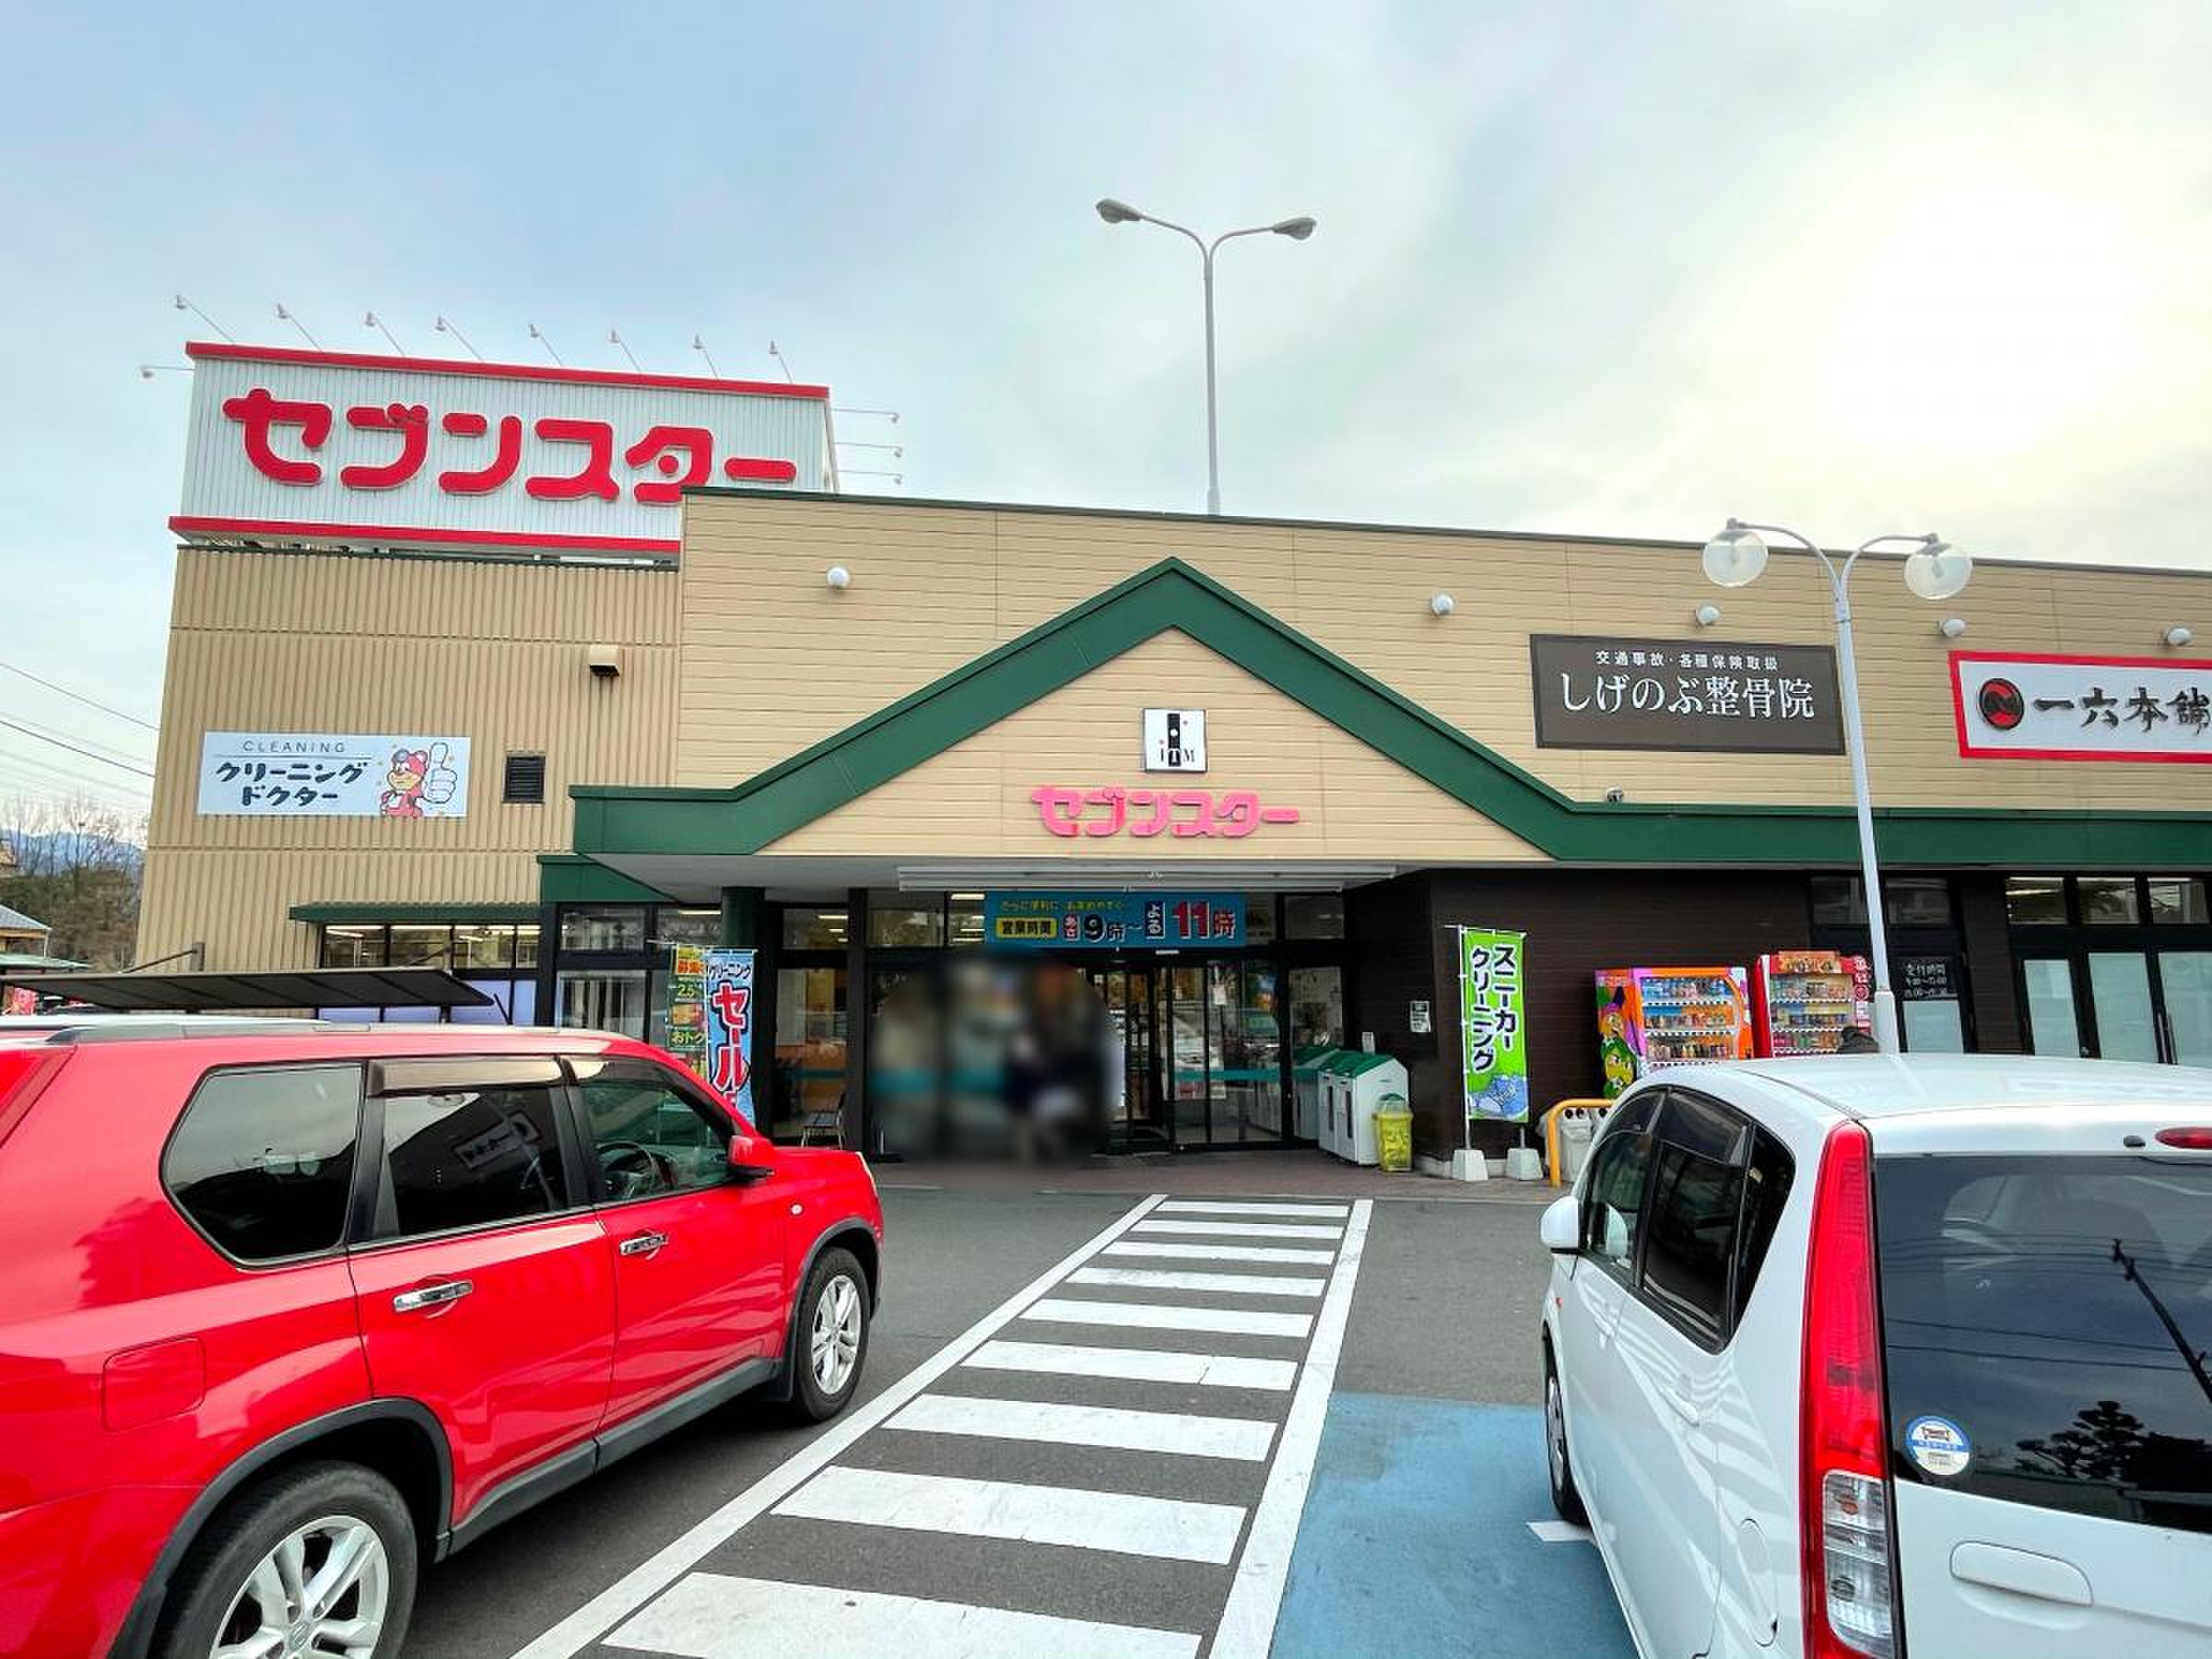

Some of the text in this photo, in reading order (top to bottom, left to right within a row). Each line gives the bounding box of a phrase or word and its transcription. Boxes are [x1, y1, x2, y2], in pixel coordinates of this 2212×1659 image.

[222, 388, 796, 505] セブンスター
[1560, 673, 1815, 719] しげのぶ整骨院
[216, 761, 368, 783] クリーニング
[242, 740, 345, 753] CLEANING
[241, 785, 338, 806] ドクター
[1031, 786, 1299, 838] セブンスター
[1473, 947, 1494, 1071] クリーニング
[1494, 946, 1516, 1049] スニーカー
[711, 982, 751, 1092] セール
